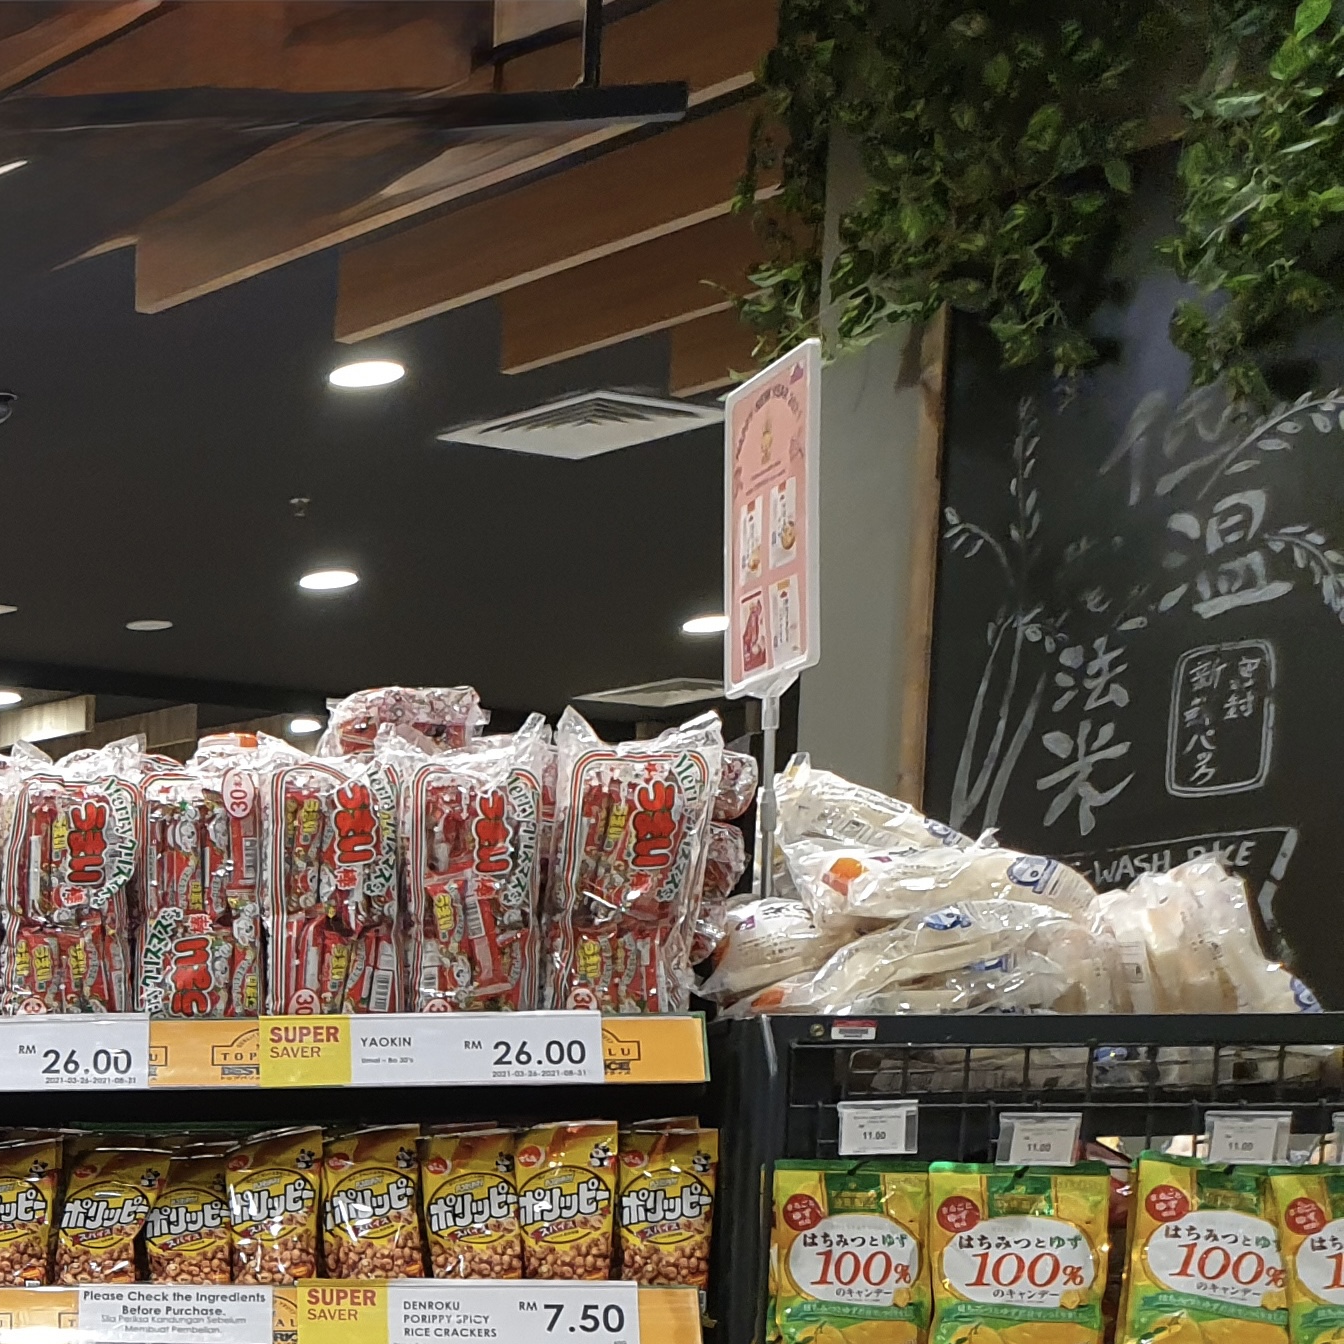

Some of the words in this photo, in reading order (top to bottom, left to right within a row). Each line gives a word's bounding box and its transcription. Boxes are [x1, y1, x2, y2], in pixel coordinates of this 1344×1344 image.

[361, 1037, 411, 1048] YAOKIN
[18, 1045, 36, 1054] RM
[493, 1040, 586, 1066] 26.00
[42, 1049, 132, 1075] 26.00
[959, 1235, 1082, 1250] はちみつとゆず
[965, 1252, 1084, 1287] 100%
[404, 1301, 460, 1310] DENROKU
[519, 1302, 537, 1311] RM
[404, 1315, 452, 1324] PORIPPY
[543, 1304, 625, 1334] 7.50
[404, 1328, 430, 1337] RICE
[434, 1328, 497, 1337] CRACKERS
